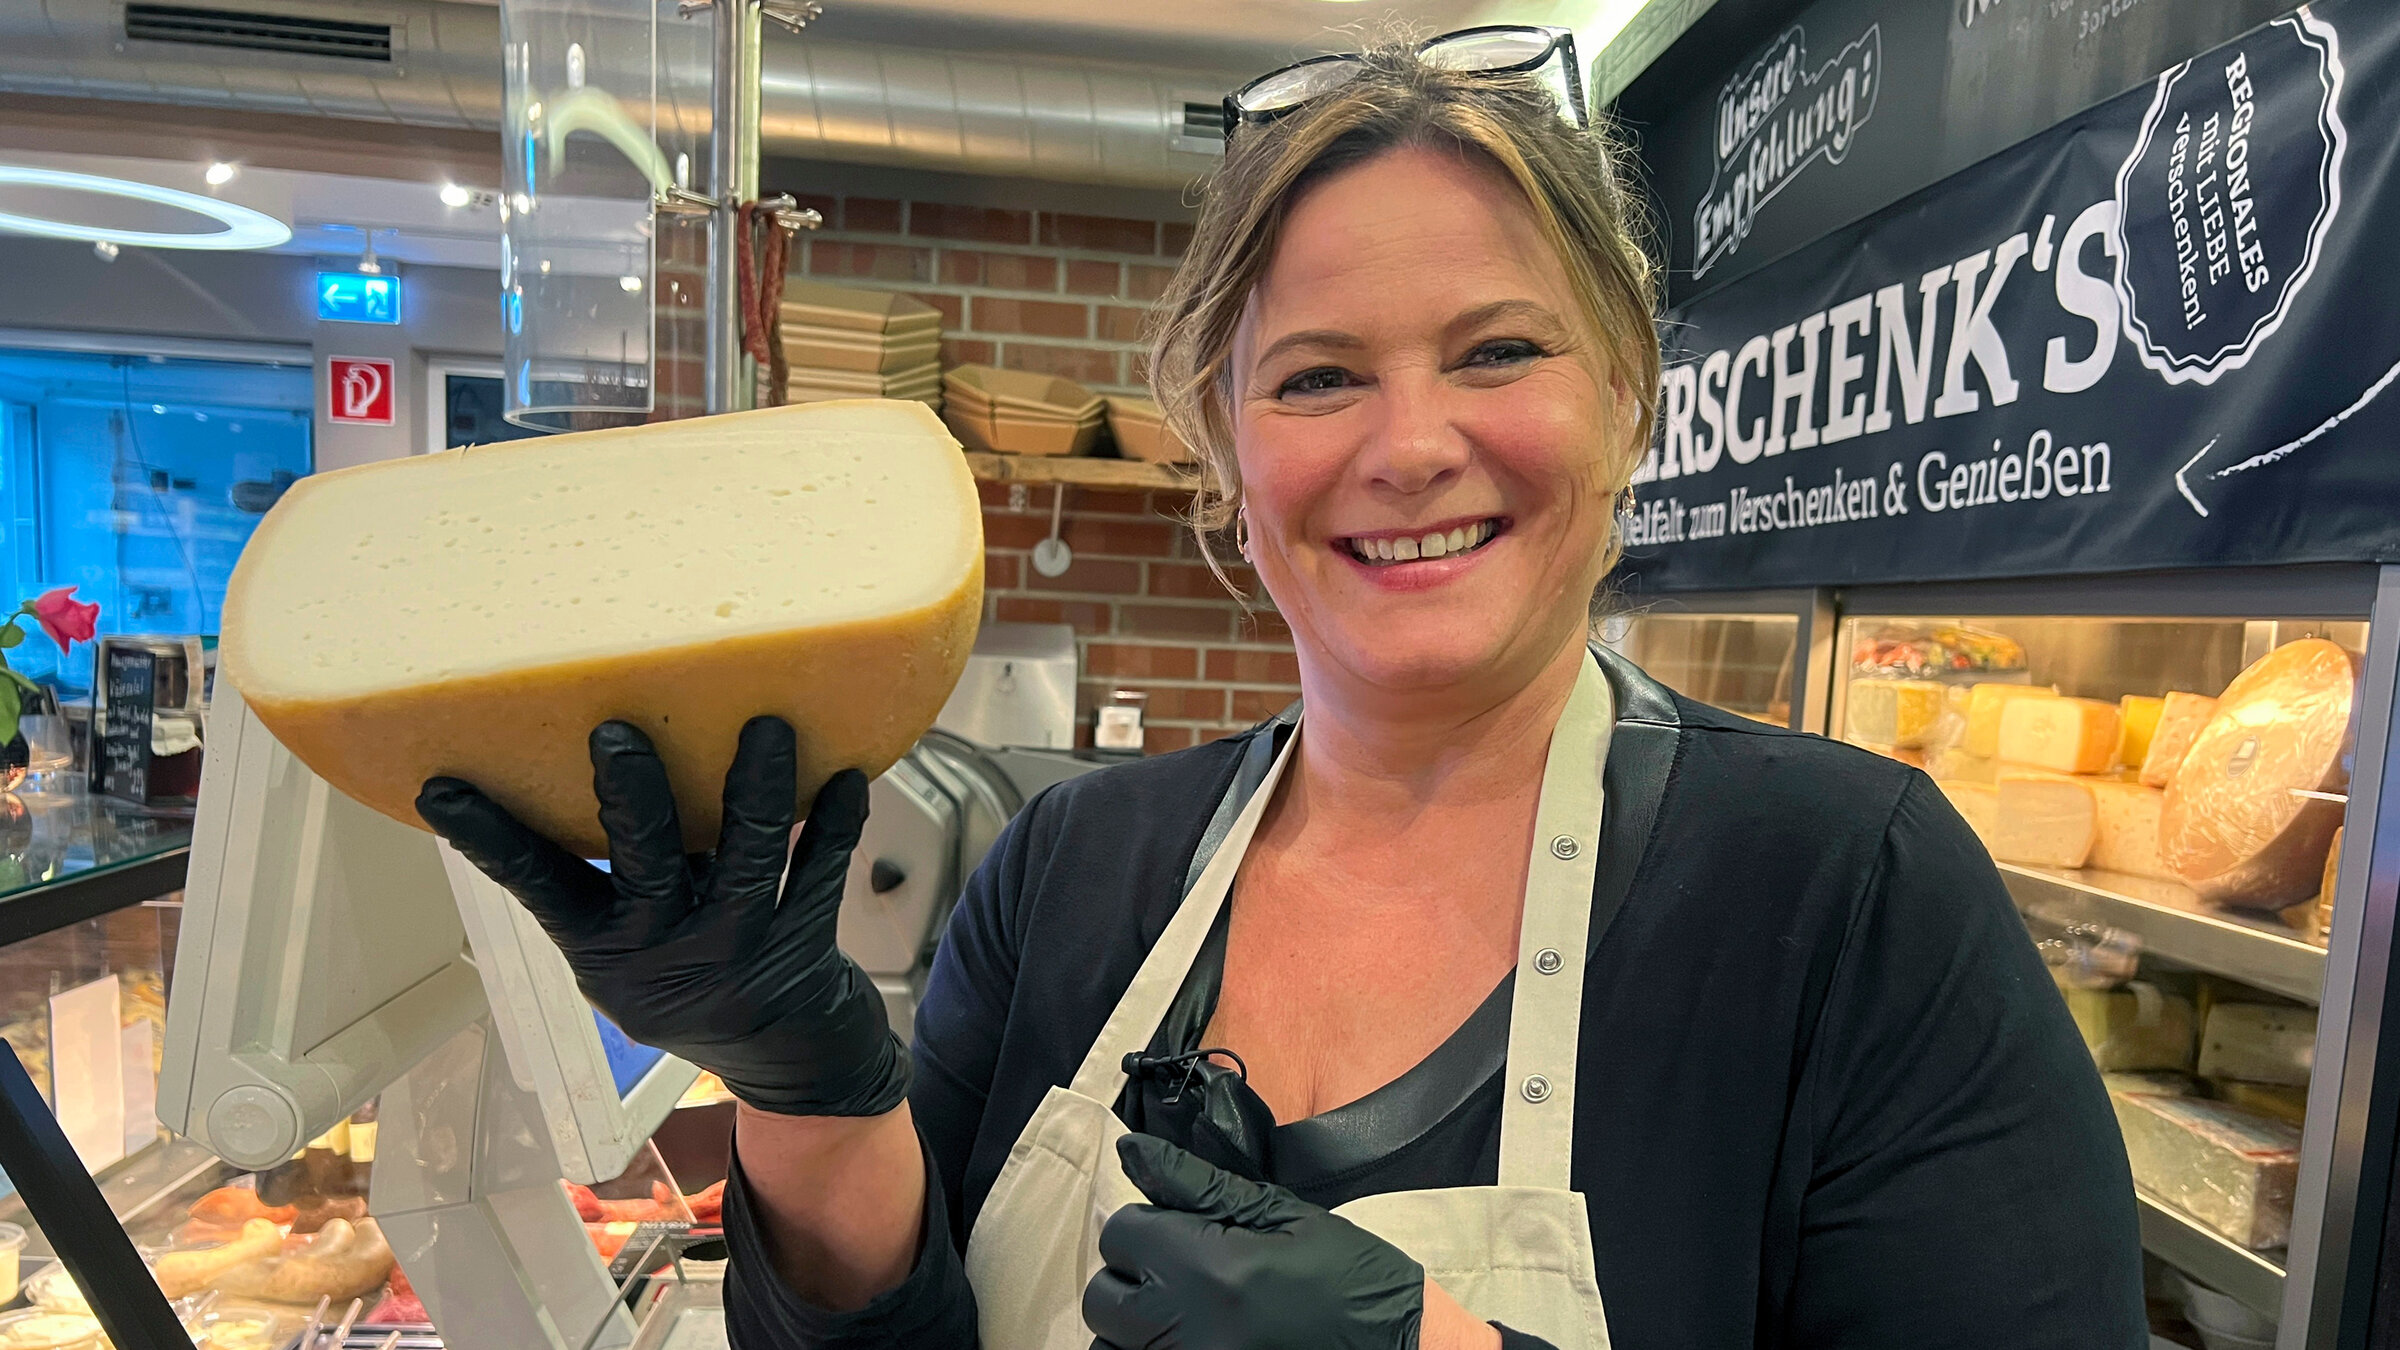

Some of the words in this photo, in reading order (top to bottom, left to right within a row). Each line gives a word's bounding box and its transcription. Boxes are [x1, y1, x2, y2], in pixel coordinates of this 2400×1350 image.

[1698, 50, 1872, 260] Empfehlung:
[1719, 43, 1798, 159] Unsere
[2196, 111, 2219, 174] mit
[2168, 111, 2207, 330] verschenken!
[2197, 170, 2230, 286] LIEBE
[2225, 52, 2269, 293] REGIONALES
[1621, 497, 1686, 547] ielfalt
[1687, 502, 1726, 541] zum
[1729, 467, 1879, 535] Verschenken
[1883, 462, 1908, 517] &
[1917, 428, 2111, 512] Genießen
